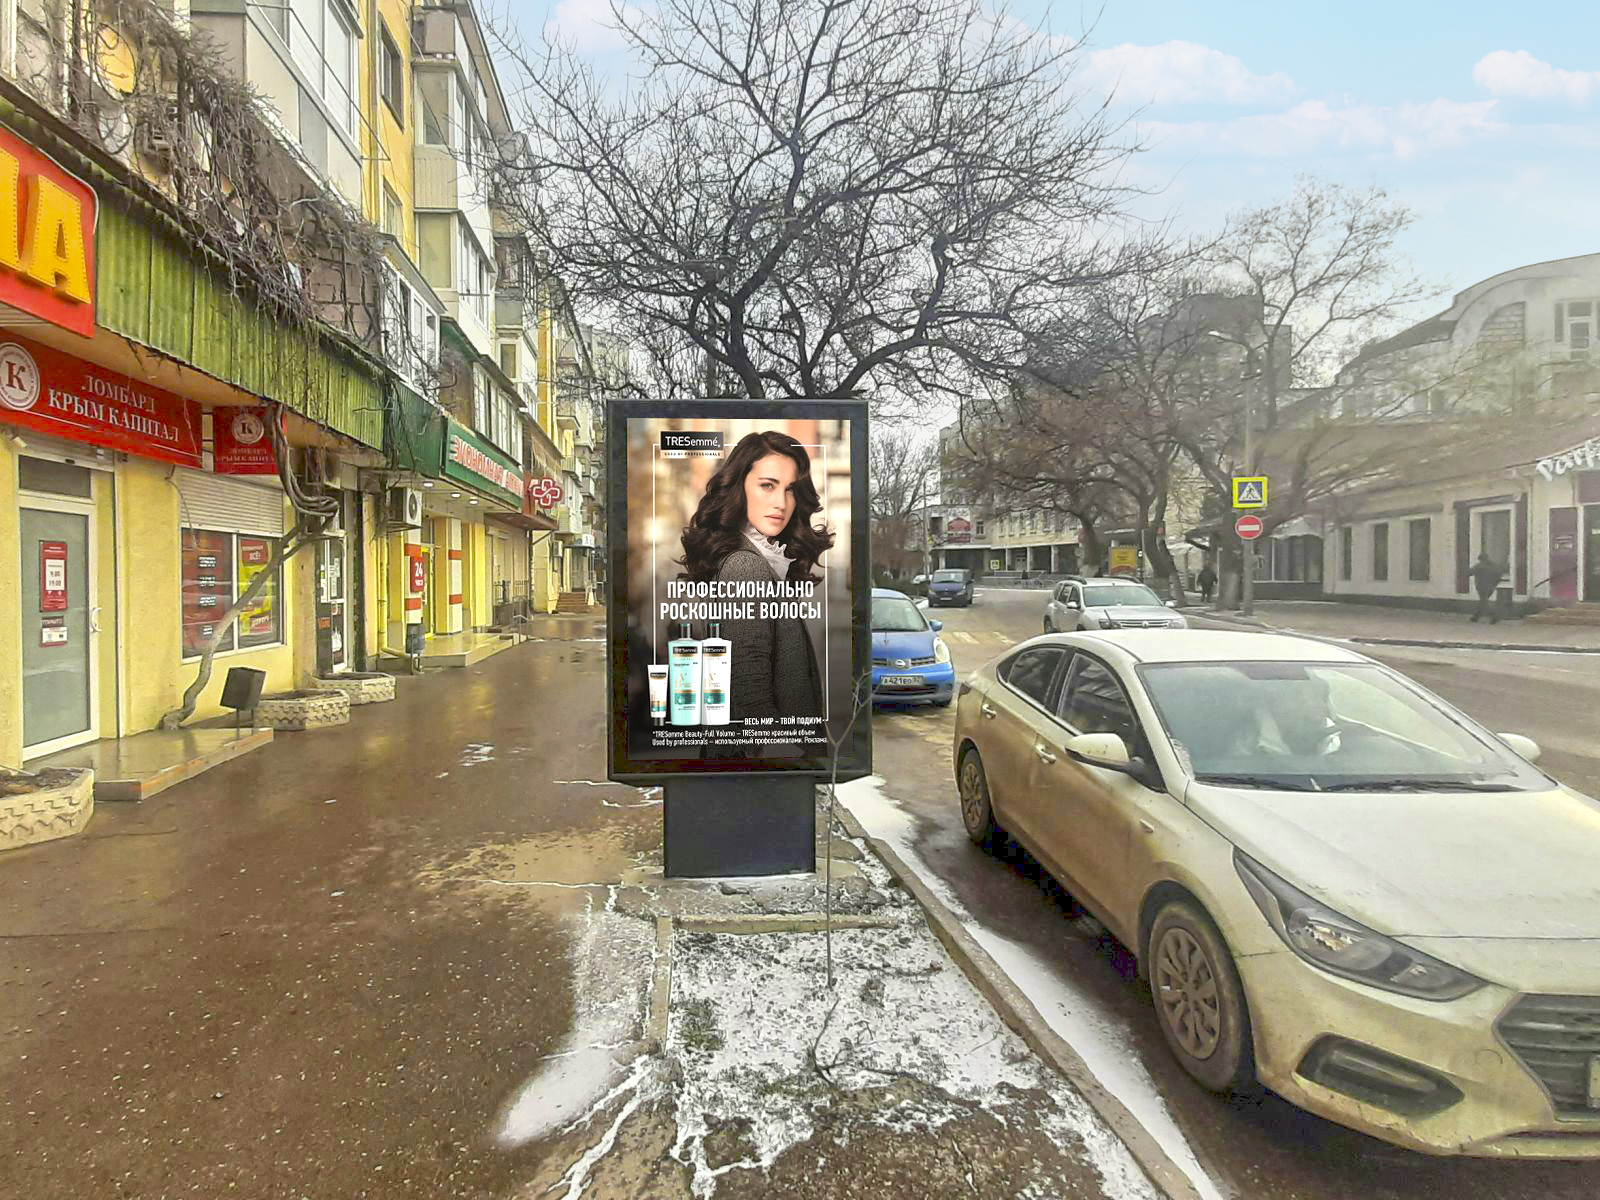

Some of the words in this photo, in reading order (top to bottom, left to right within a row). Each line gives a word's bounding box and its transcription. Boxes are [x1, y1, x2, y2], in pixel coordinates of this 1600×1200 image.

[81, 375, 156, 415] ЛОМБАРД
[48, 387, 104, 422] КРЫМ
[109, 406, 179, 442] КАПИТАЛ
[667, 580, 814, 599] ПРОФЕССИОНАЛЬНО
[660, 602, 755, 620] РОСКОШНЫЕ
[760, 601, 821, 620] ВОЛОСЫ
[744, 717, 760, 725] ВЕСЬ
[760, 717, 774, 725] МИР
[780, 716, 796, 725] ТВОЙ
[796, 716, 822, 726] ПОДИУМ
